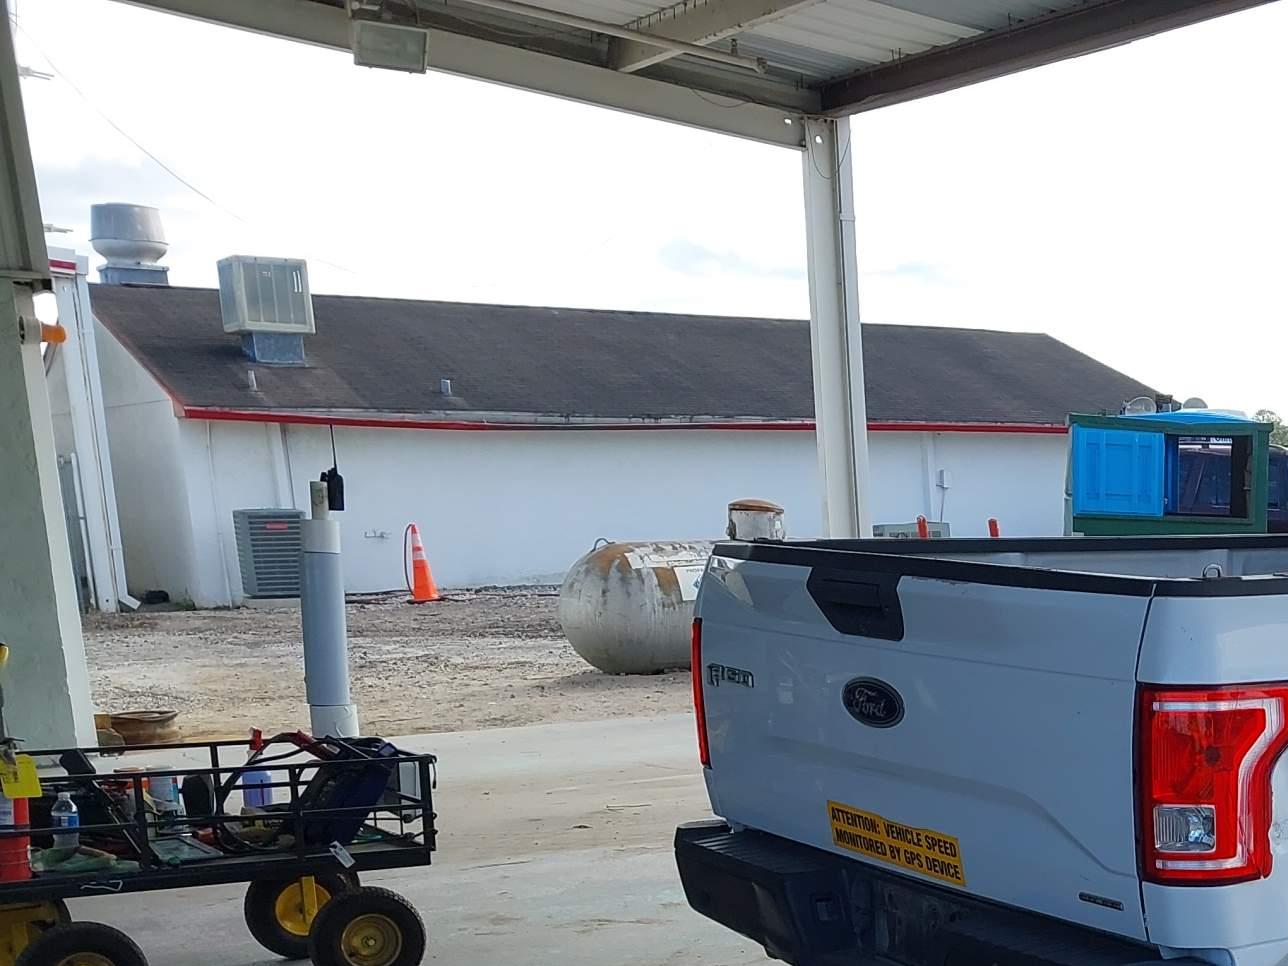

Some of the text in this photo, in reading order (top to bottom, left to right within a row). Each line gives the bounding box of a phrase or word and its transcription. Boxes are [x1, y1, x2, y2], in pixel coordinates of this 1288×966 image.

[852, 686, 887, 718] Ford
[831, 806, 957, 858] ATTENTION: VEHICLE SPEED
[835, 827, 962, 881] MONITORED BY GPS DEVICE
